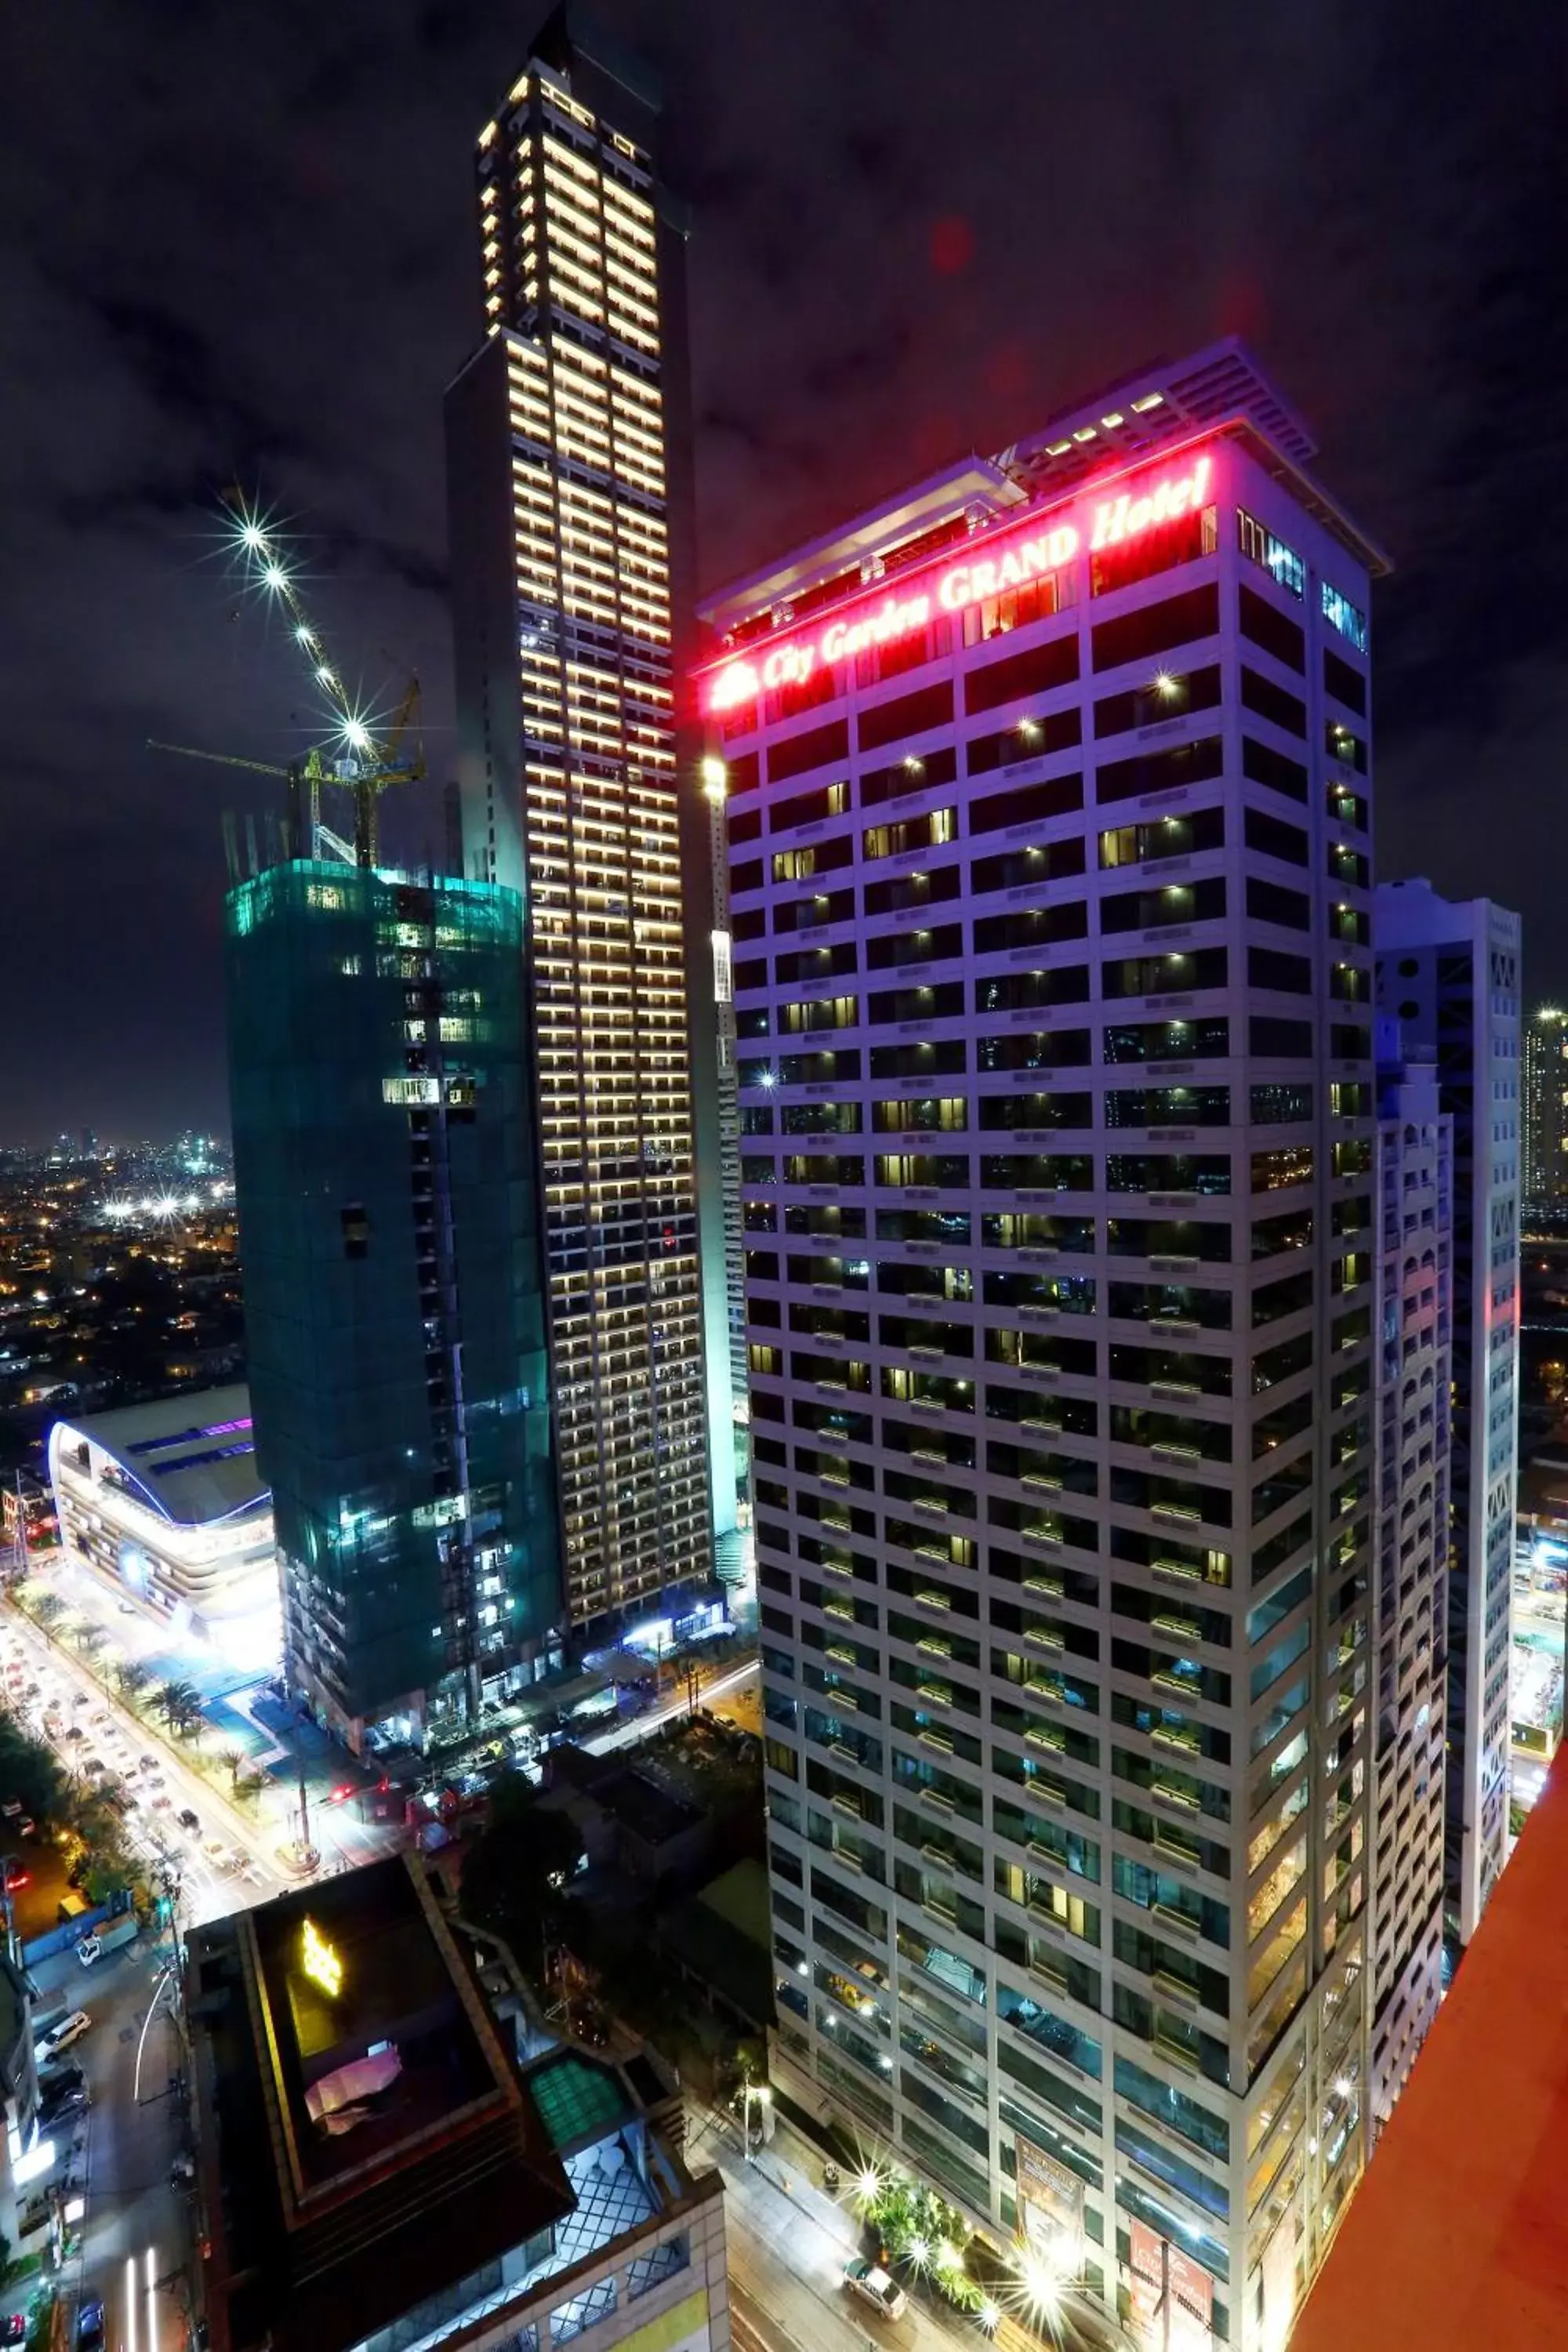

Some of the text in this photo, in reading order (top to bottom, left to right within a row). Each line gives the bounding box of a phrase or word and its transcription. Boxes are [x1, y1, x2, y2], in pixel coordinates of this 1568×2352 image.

[763, 458, 1212, 688] City Garden GRAND Hotel
